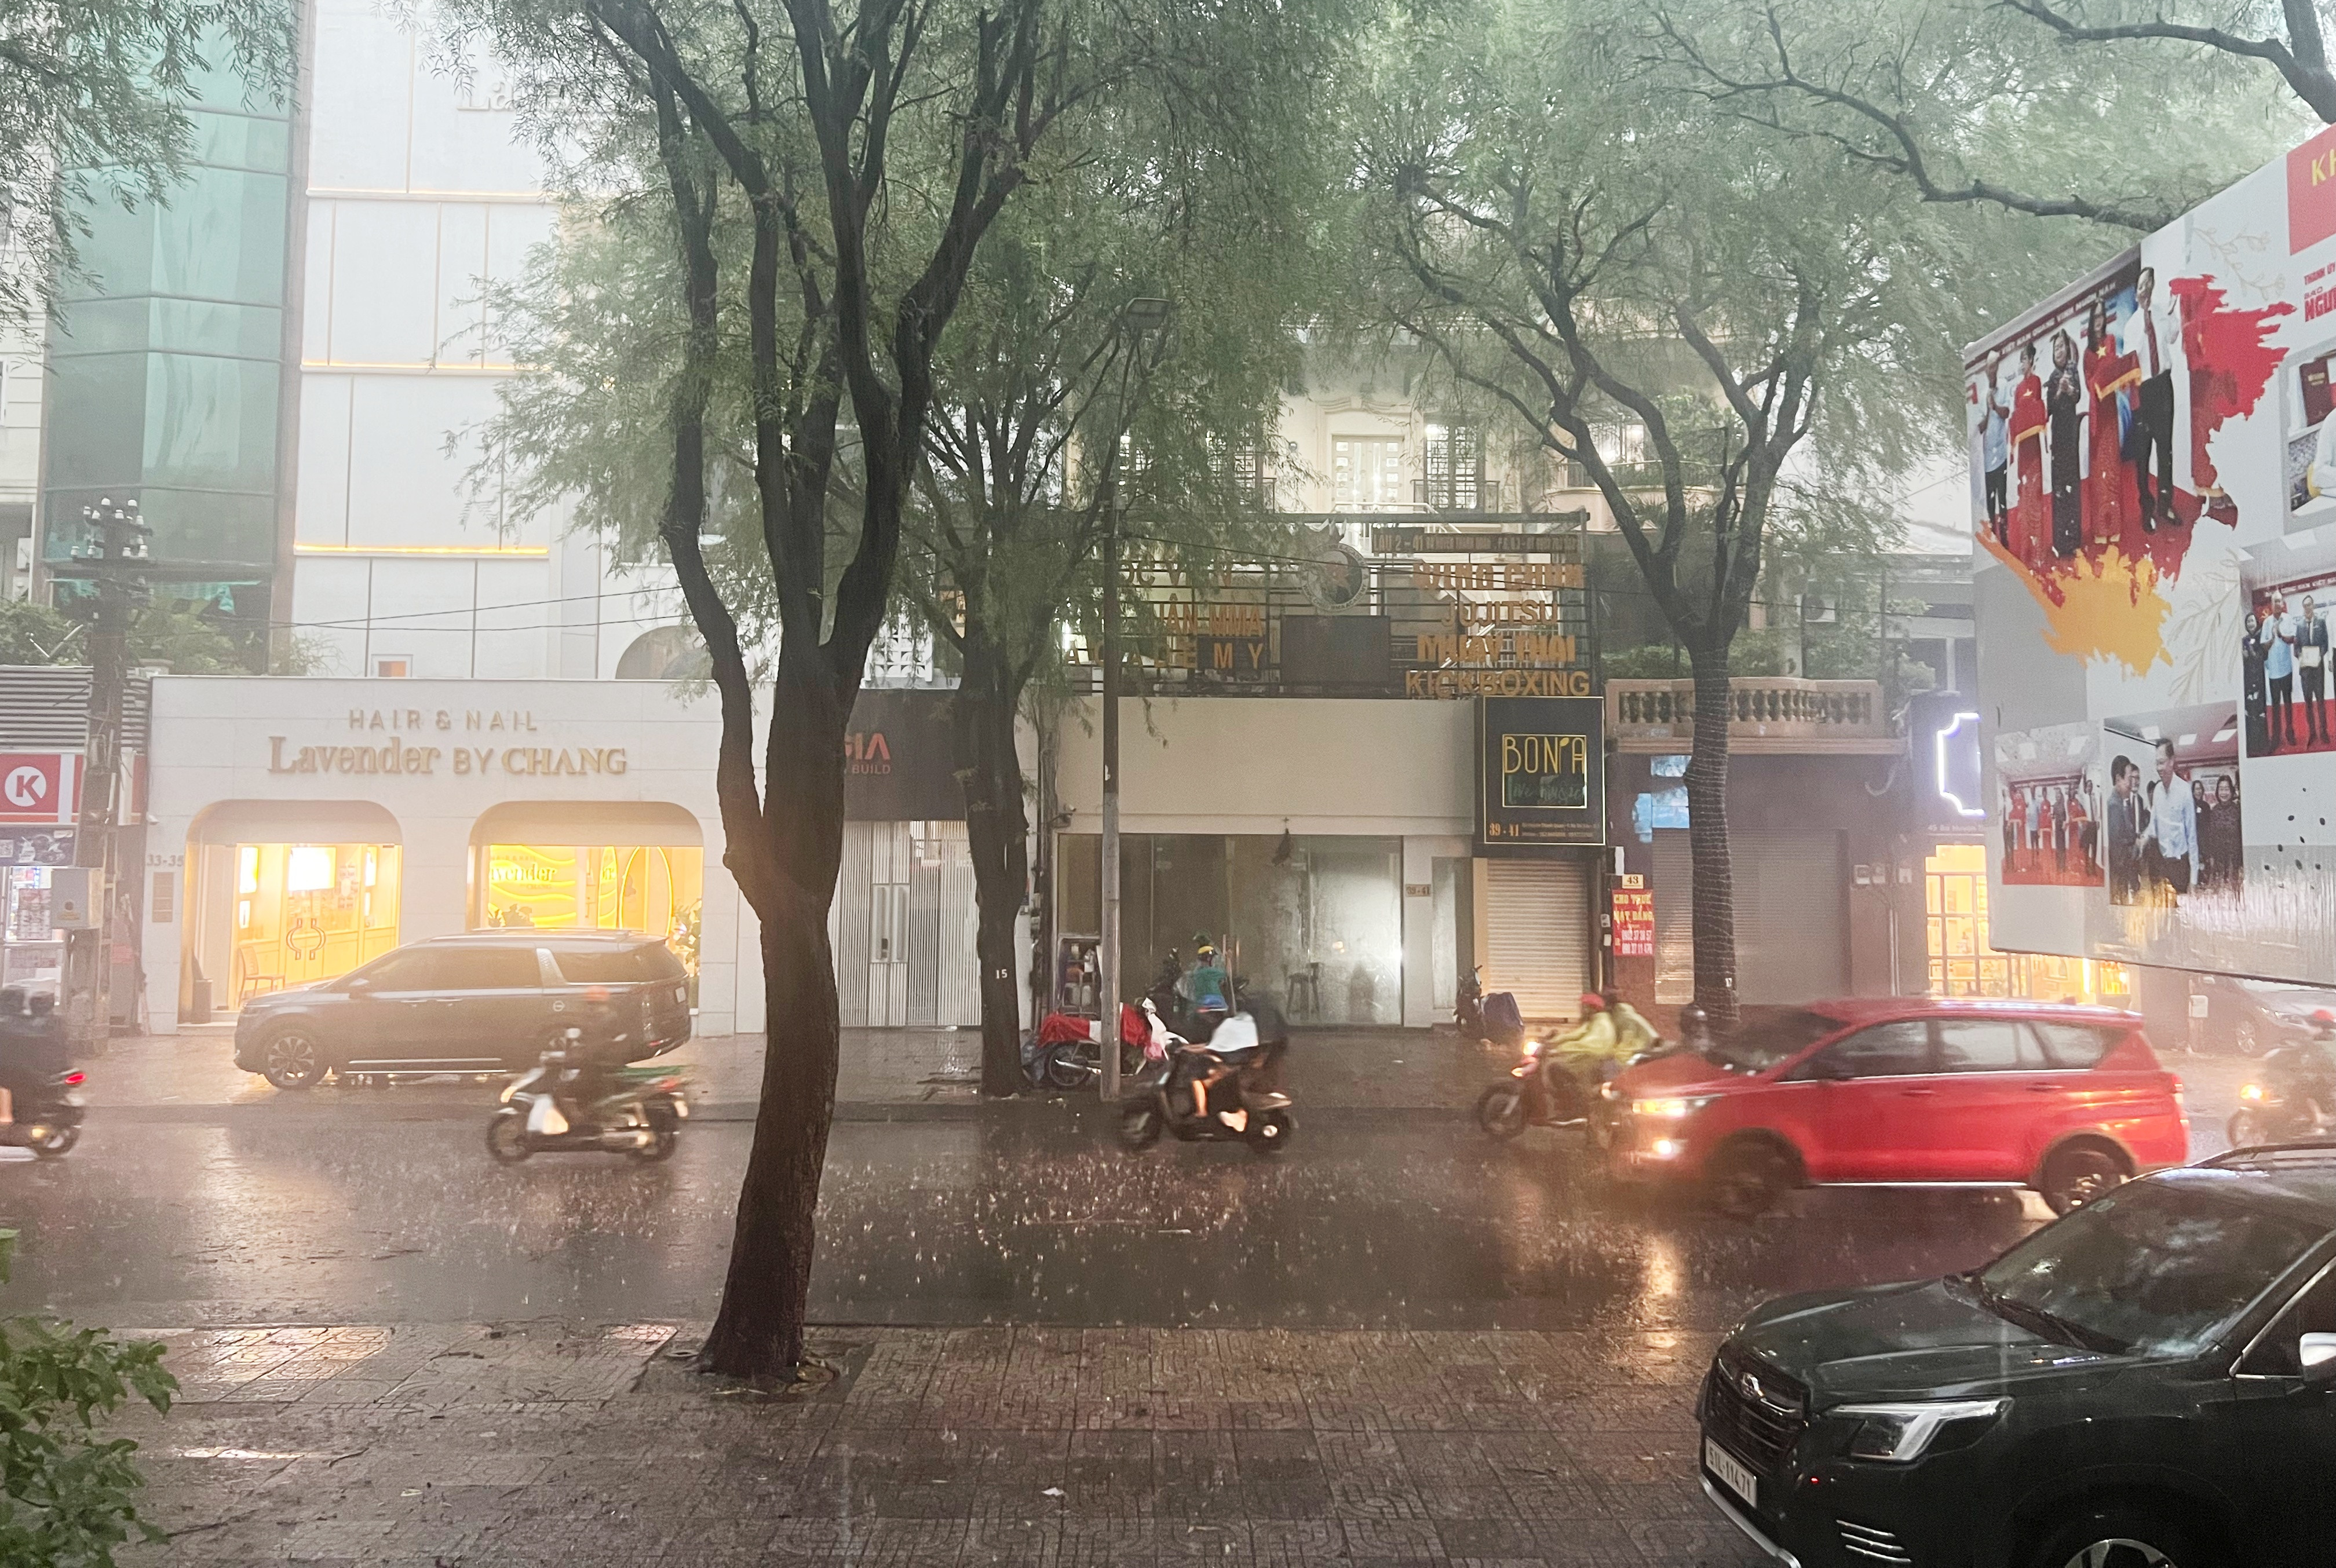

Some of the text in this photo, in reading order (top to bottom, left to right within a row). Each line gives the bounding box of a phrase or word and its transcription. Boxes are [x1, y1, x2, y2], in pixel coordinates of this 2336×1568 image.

[1441, 600, 1558, 627] JUJITSU
[1406, 670, 1590, 697] KICKBOXING
[349, 710, 538, 730] HAIR & NAIL
[268, 736, 627, 775] Lavender BY CHANG
[852, 765, 891, 774] BUILD
[996, 968, 1008, 979] 15
